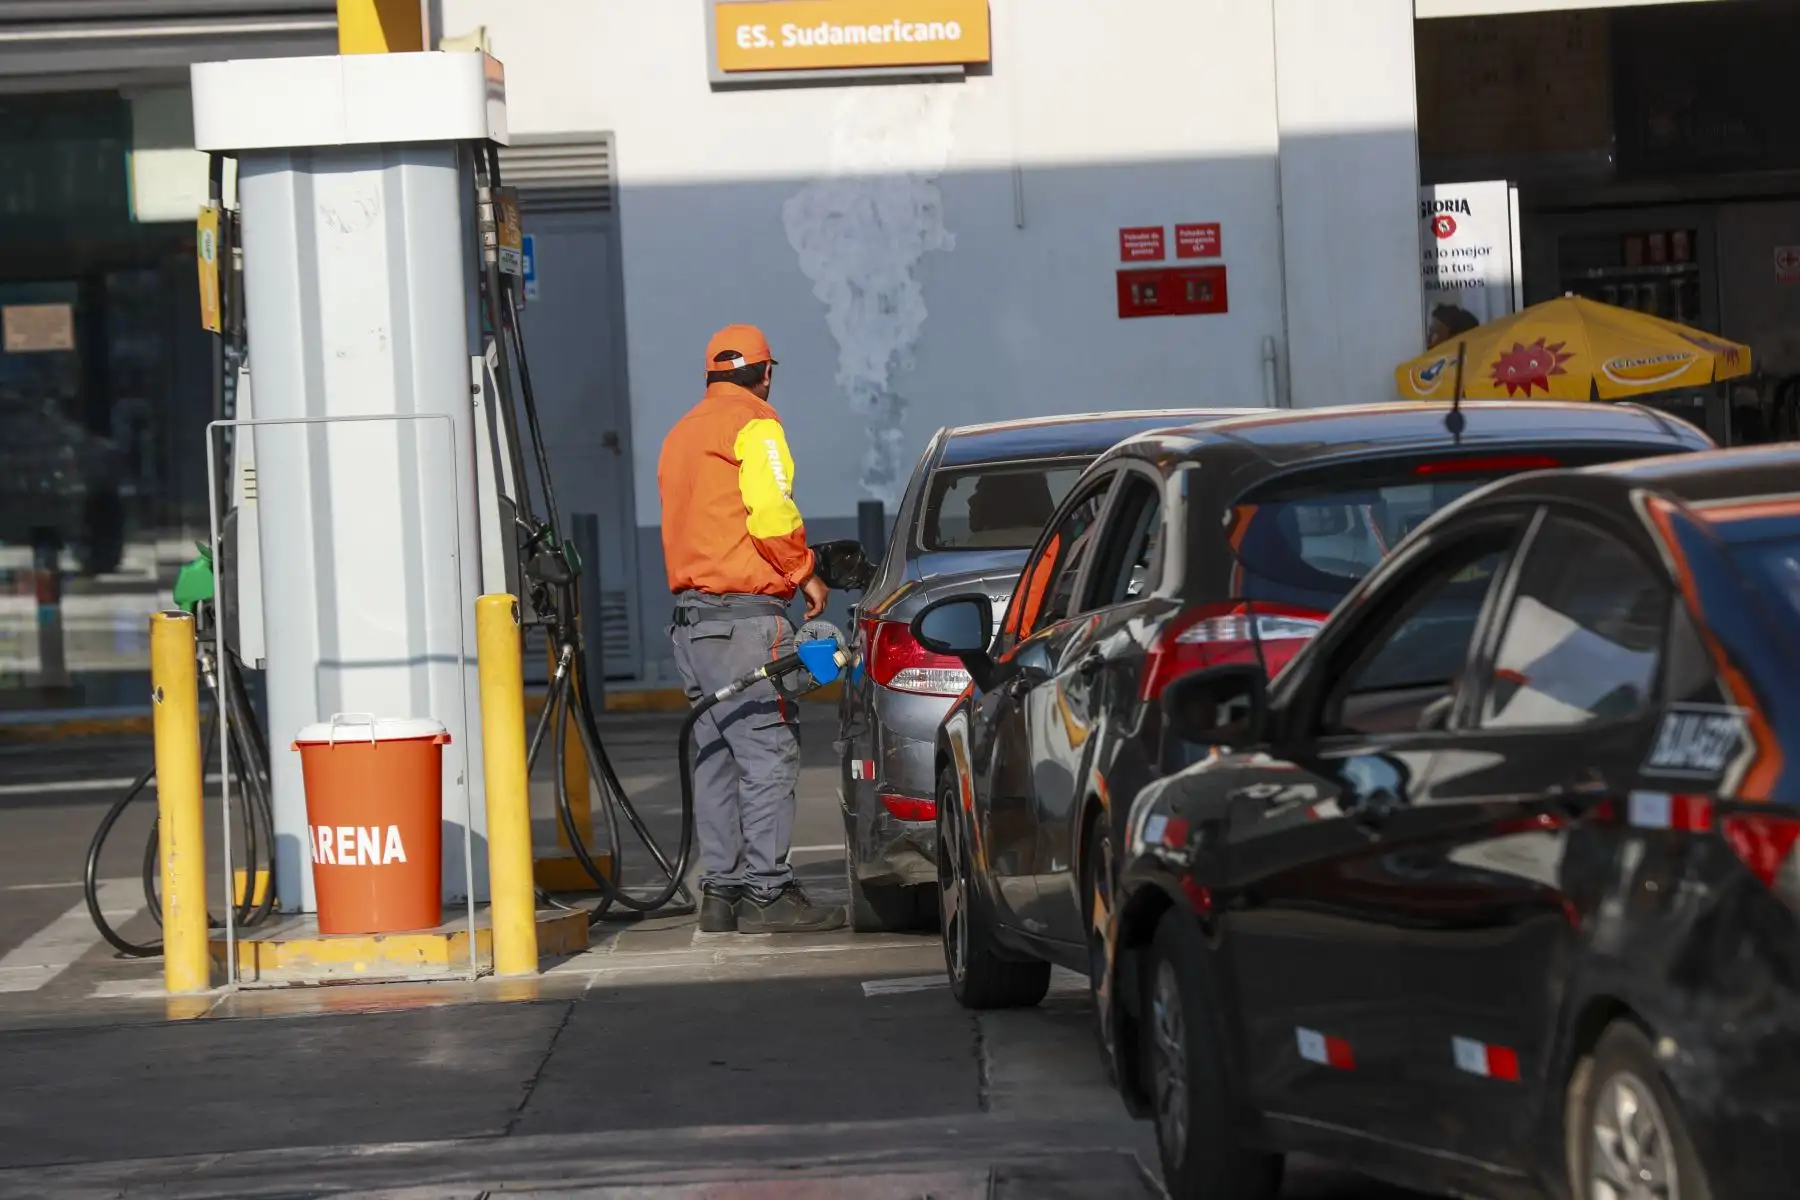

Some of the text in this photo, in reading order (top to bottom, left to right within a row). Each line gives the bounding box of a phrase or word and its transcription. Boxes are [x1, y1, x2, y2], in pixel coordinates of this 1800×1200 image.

[736, 19, 962, 49] ES. Sudamericano
[1435, 247, 1448, 258] lo
[1452, 245, 1492, 259] mejor
[1452, 262, 1474, 274] tus
